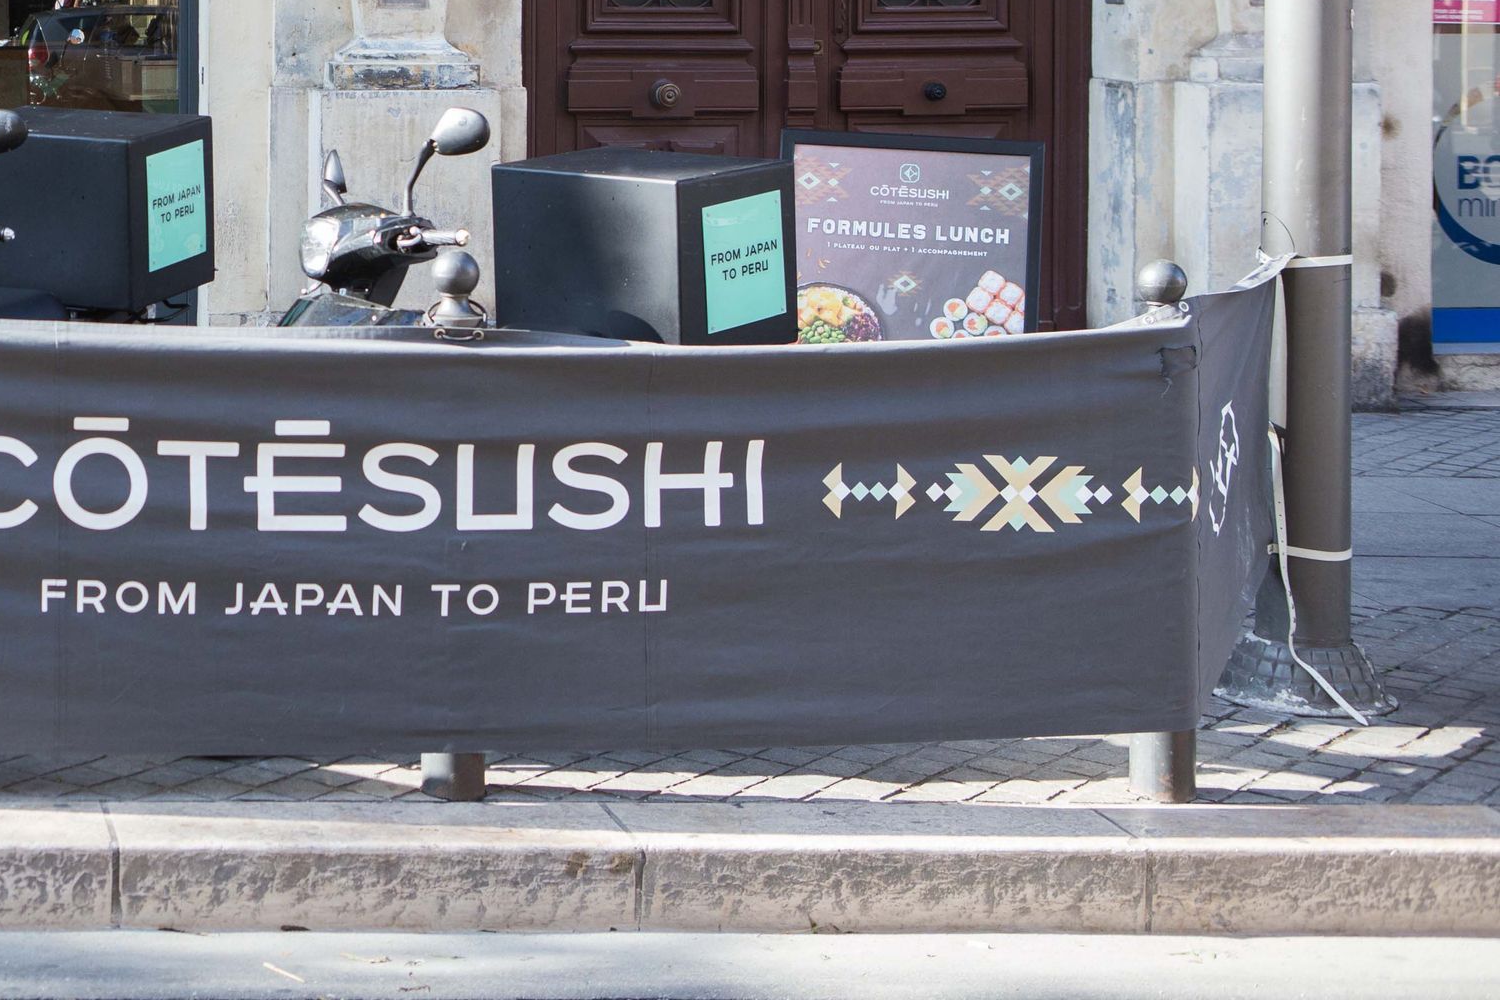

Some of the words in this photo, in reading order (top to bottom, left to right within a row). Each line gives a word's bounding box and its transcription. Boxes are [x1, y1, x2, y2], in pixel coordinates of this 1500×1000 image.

[152, 193, 175, 210] FROM
[177, 183, 201, 202] JAPAN
[161, 211, 172, 223] TO
[175, 202, 195, 219] PERU
[807, 217, 927, 241] FORMULES
[935, 225, 1010, 245] LUNCH
[711, 247, 741, 266] FROM
[745, 239, 778, 258] JAPAN
[833, 242, 866, 250] PLATEAU
[918, 248, 988, 257] ACCOMPAGNEMENT
[722, 268, 737, 281] TO
[741, 259, 769, 276] PERU
[40, 578, 197, 615] FROM
[224, 582, 403, 616] JAPAN
[431, 583, 500, 616] TO
[526, 578, 668, 613] PERU
